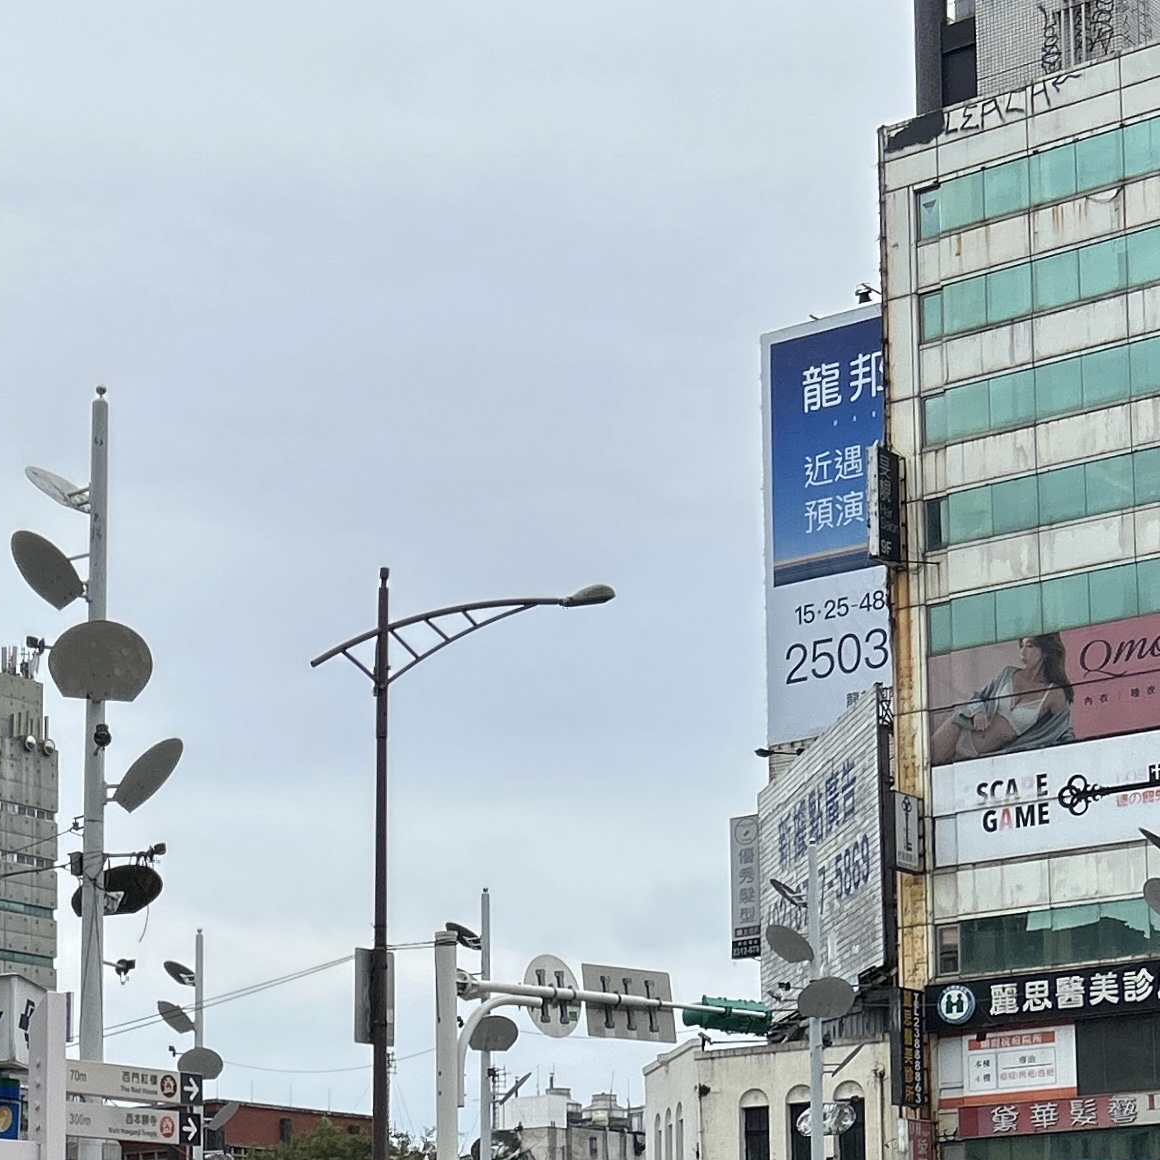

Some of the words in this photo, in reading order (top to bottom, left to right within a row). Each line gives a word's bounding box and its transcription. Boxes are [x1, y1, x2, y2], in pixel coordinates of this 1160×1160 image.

[804, 439, 879, 488] 近遇
[804, 490, 865, 534] 預演
[785, 627, 889, 685] 2503
[982, 802, 1050, 833] GAME
[989, 967, 1160, 1016] 麗思醫美診
